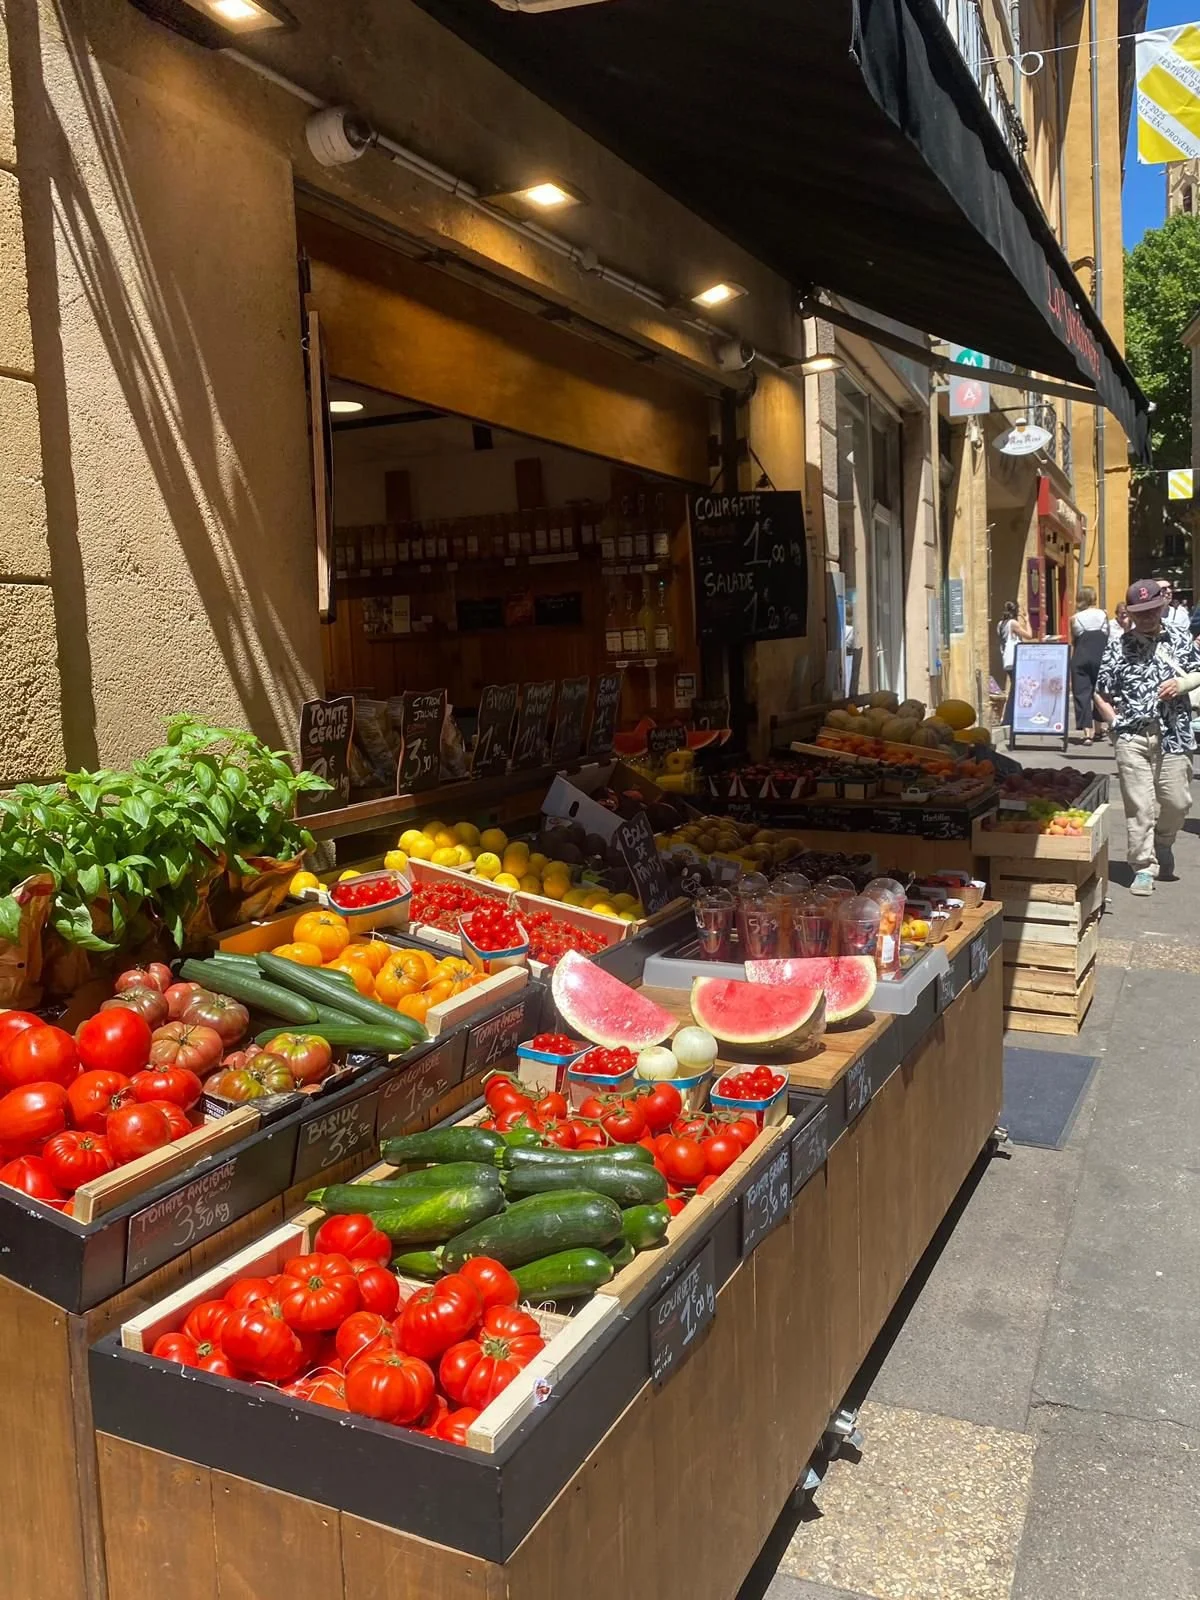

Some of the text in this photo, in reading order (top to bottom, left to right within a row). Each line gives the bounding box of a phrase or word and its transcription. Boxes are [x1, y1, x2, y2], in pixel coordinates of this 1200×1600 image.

[1157, 56, 1188, 84] FESTIVAL
[1149, 104, 1167, 121] 2025
[962, 387, 977, 402] A
[695, 495, 761, 520] COURGETTE
[704, 571, 754, 597] SALADE
[1138, 587, 1149, 600] B
[412, 695, 443, 708] CITRON
[309, 704, 349, 727] TOMATE
[413, 708, 439, 722] JAUNE
[308, 723, 348, 745] CERISE
[622, 819, 649, 849] BOLS
[384, 1051, 441, 1099] CONCOMBRE
[137, 1190, 186, 1233] TOMATE
[187, 1163, 237, 1201] ANCIENNE
[658, 1262, 701, 1325] COURGETTE
